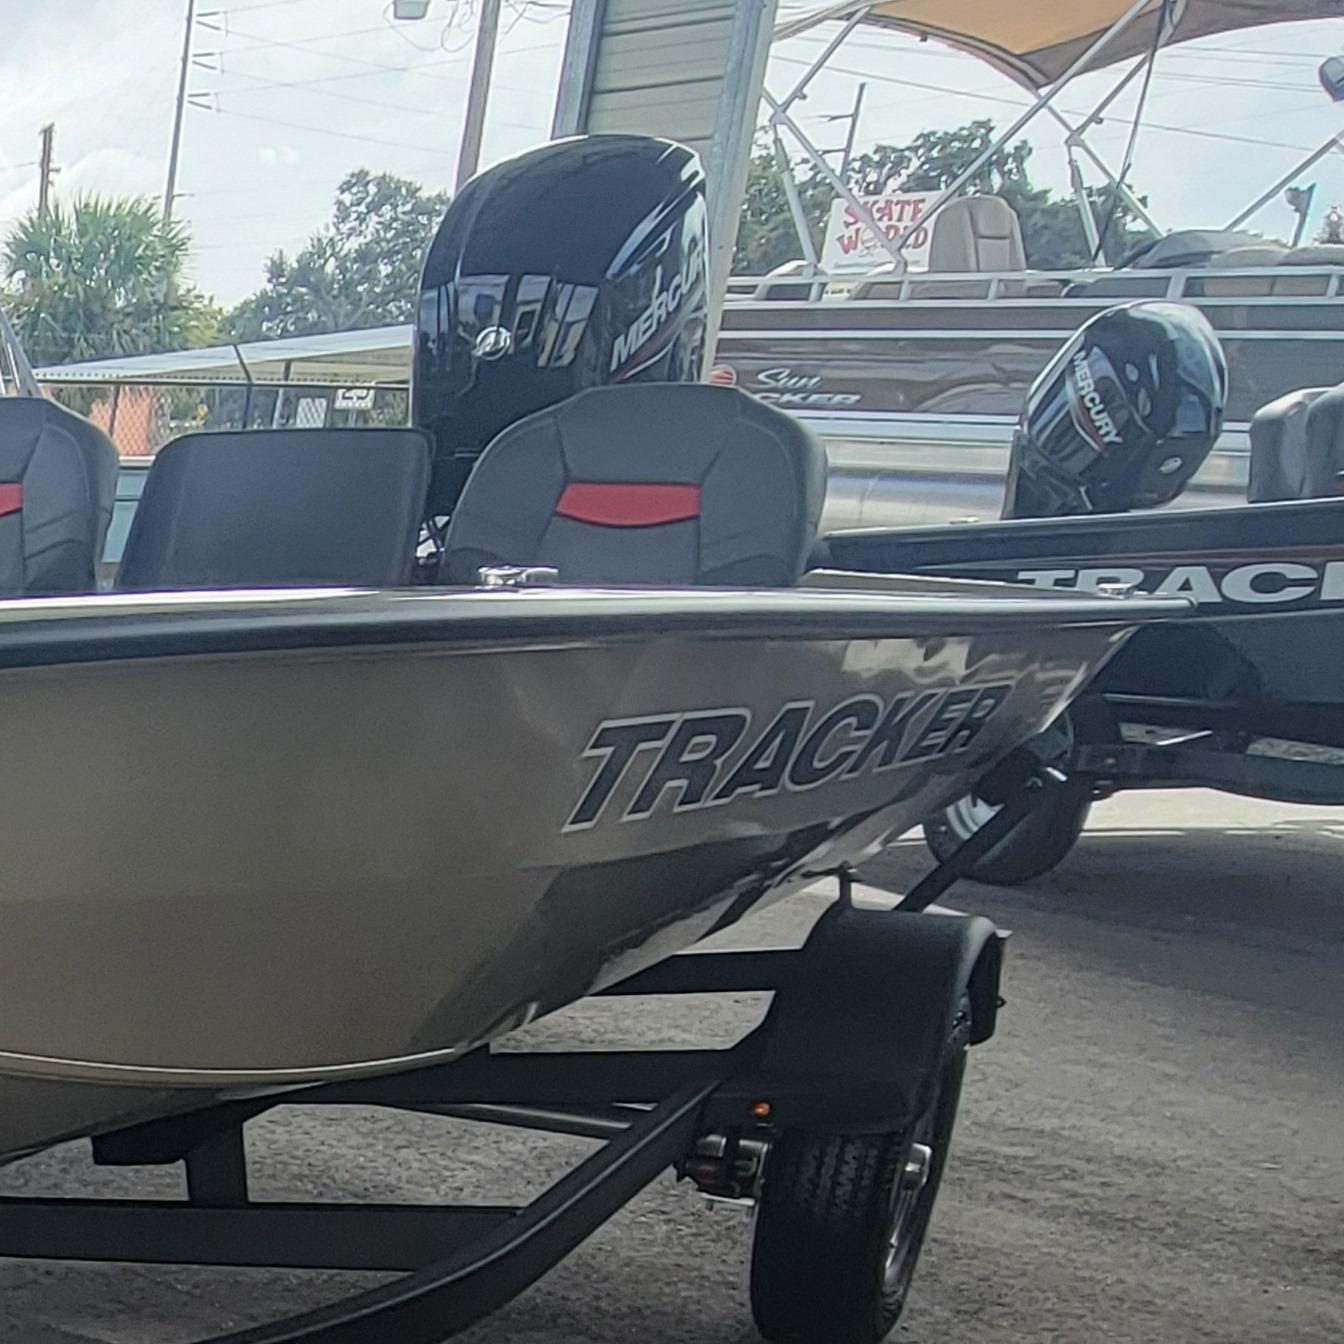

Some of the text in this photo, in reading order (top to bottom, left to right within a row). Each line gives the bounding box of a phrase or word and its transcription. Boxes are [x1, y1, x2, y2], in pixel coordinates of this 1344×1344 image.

[610, 238, 703, 372] MERCUR
[755, 392, 862, 405] CKER
[1073, 349, 1124, 443] MERCURY
[561, 681, 1014, 833] TRACKER
